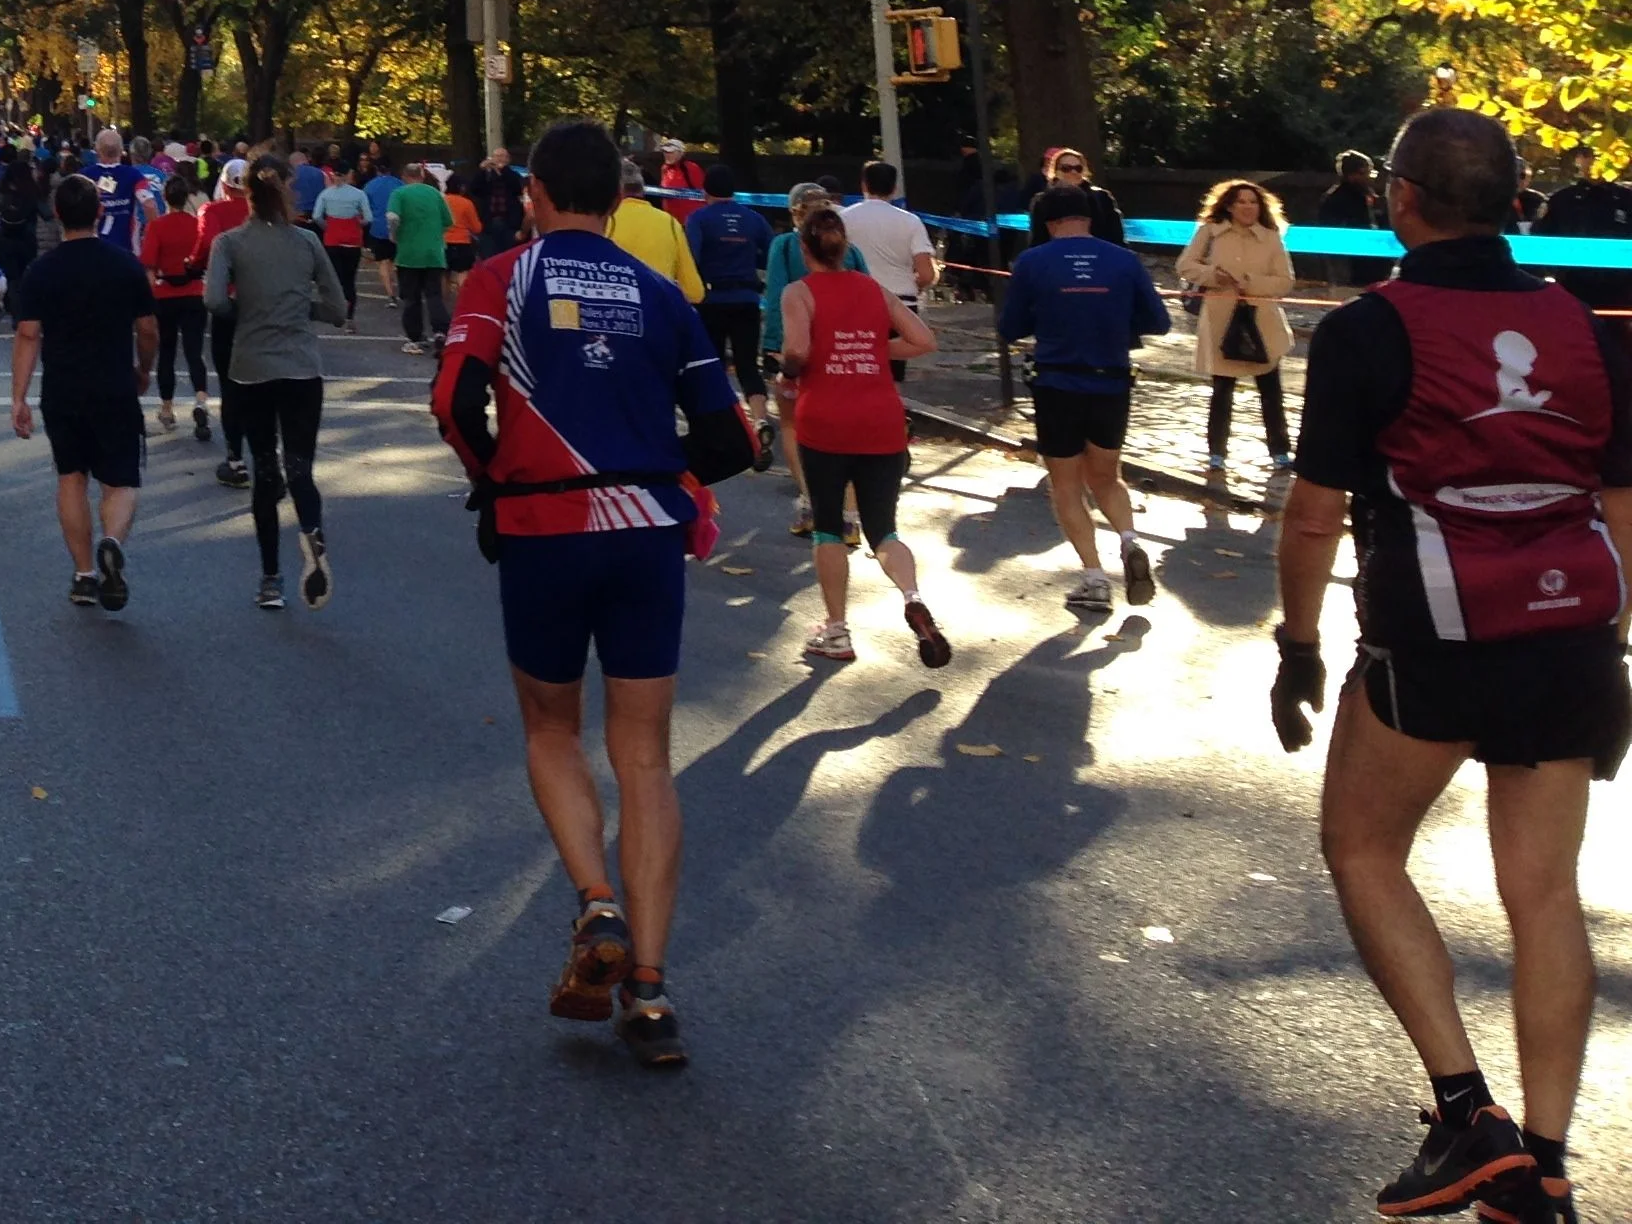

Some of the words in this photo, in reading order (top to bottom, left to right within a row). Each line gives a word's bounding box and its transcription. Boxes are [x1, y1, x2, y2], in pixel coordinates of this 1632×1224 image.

[541, 257, 598, 270] Thomas
[599, 261, 636, 277] Cook
[544, 268, 639, 287] Marathons
